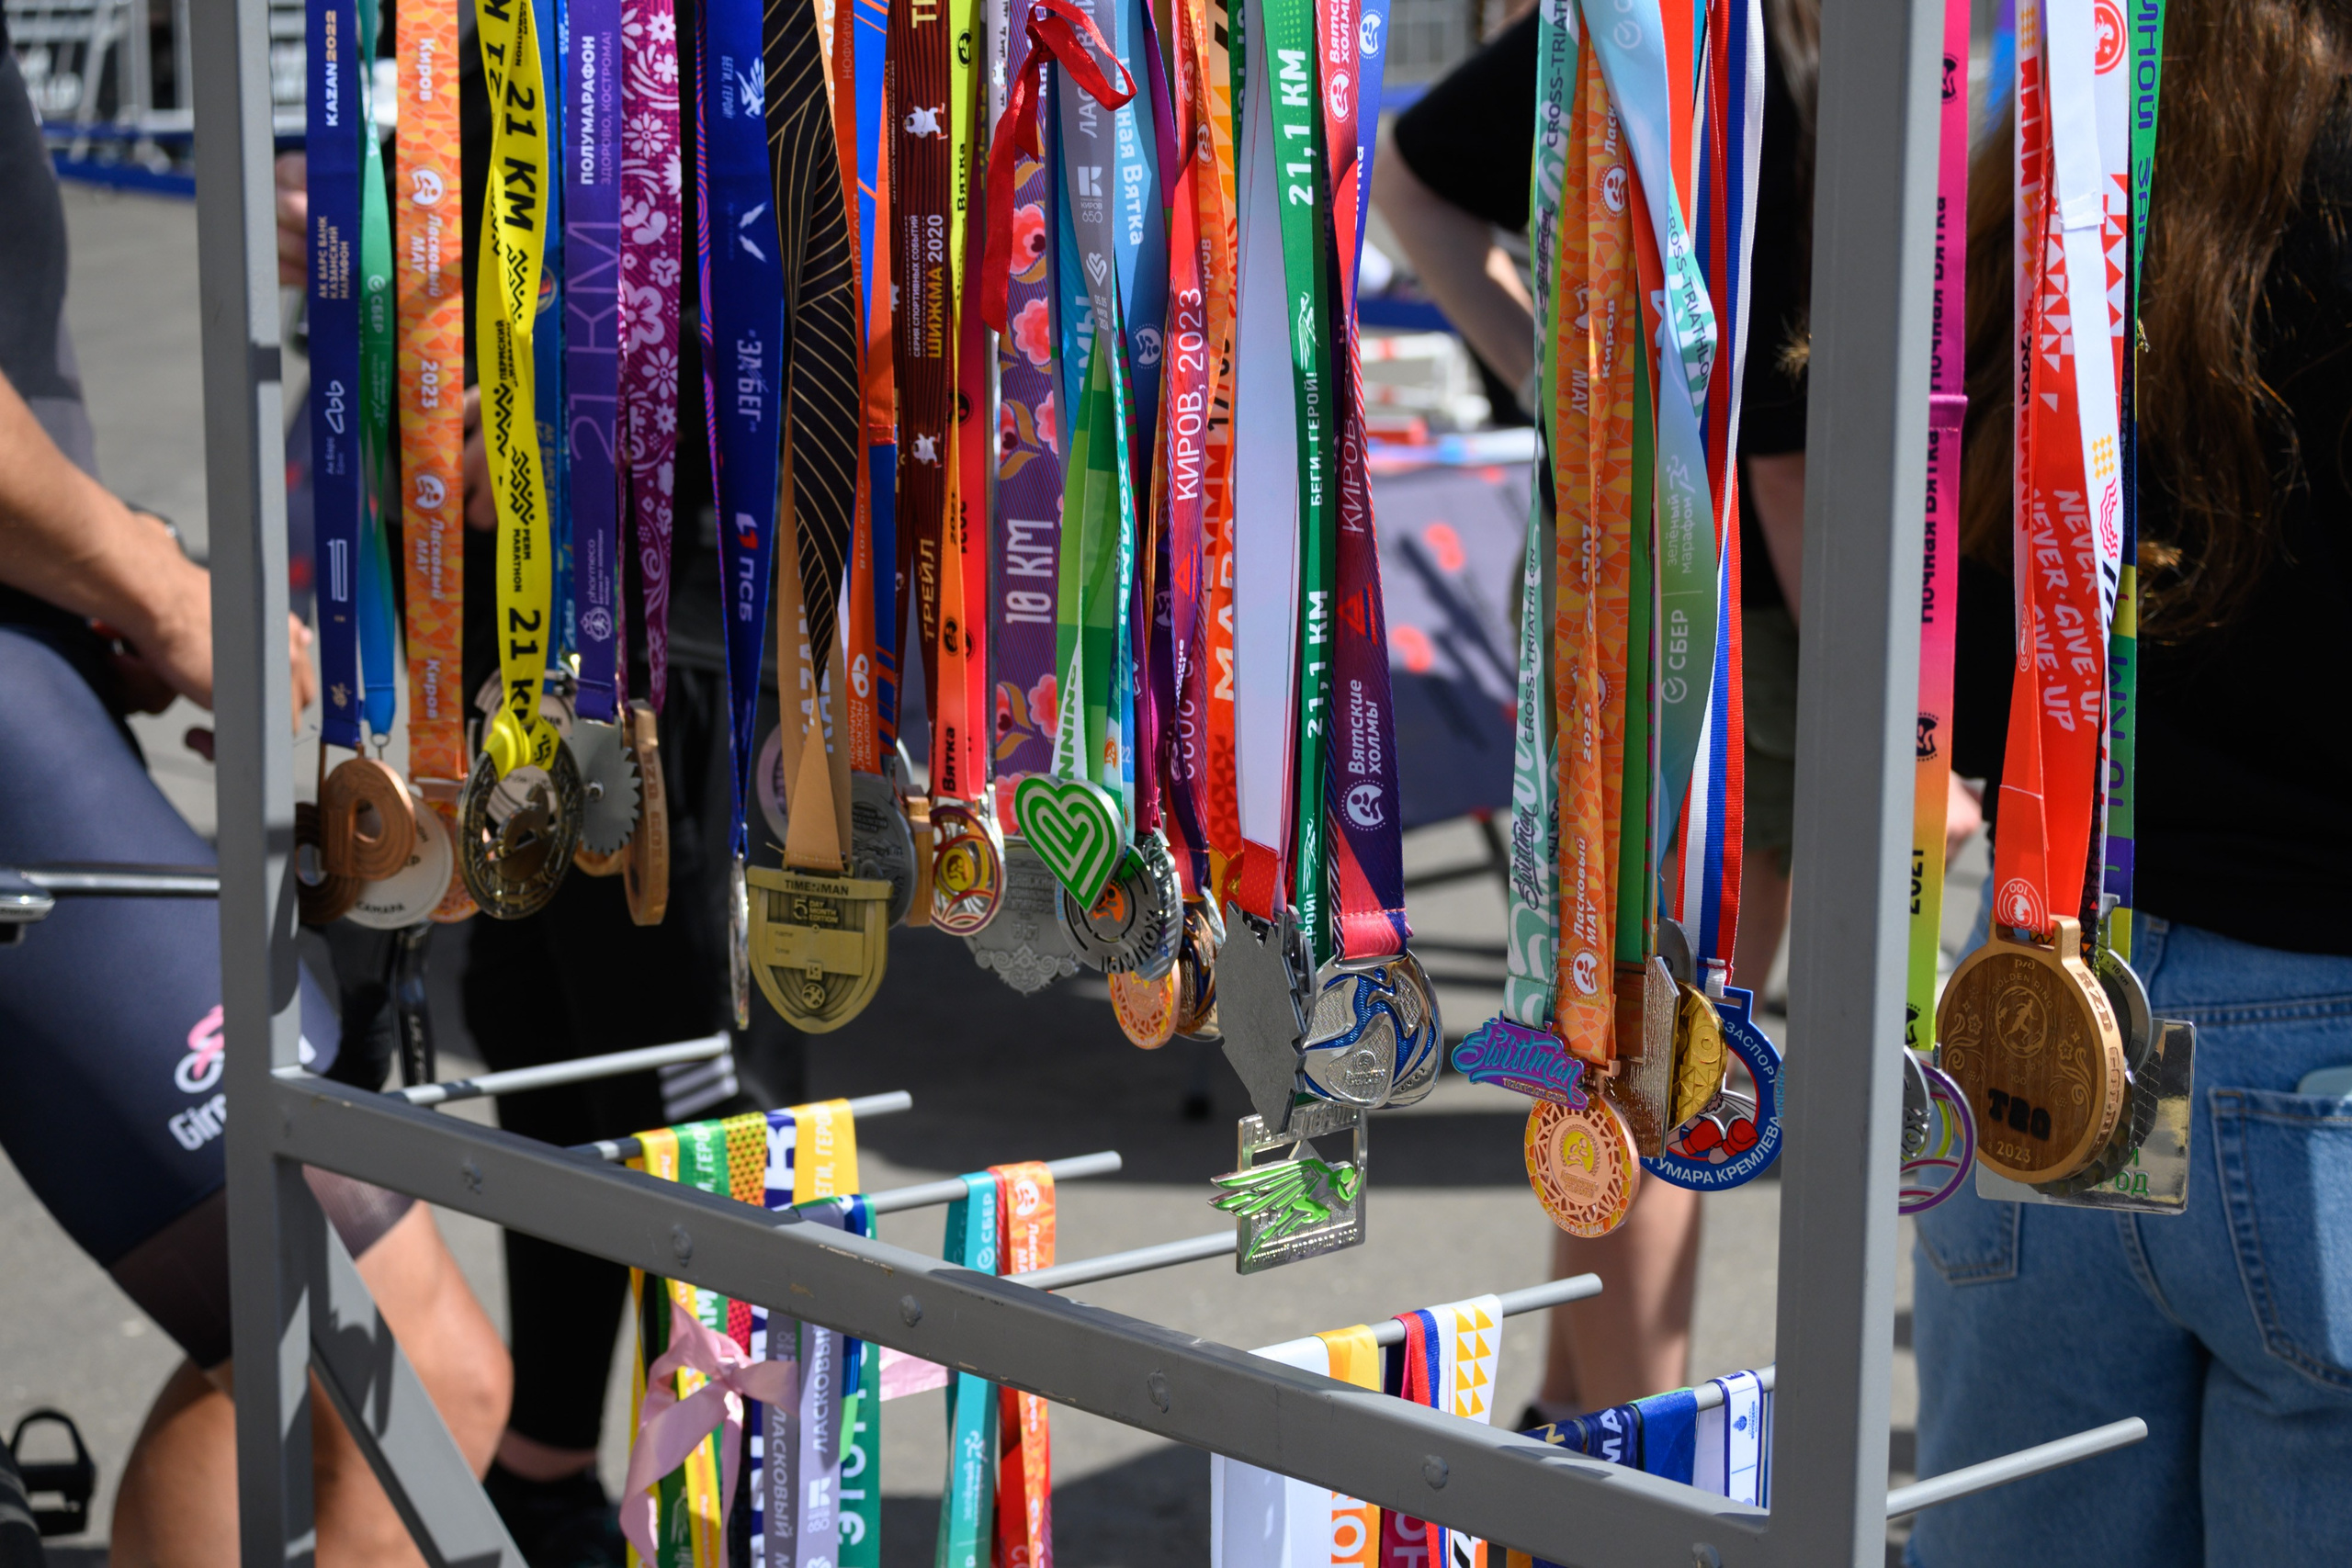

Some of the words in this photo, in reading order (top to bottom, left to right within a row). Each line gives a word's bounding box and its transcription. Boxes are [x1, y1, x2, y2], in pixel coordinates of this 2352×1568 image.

[842, 9, 853, 80] МАРАФОН
[1329, 0, 1340, 64] Вятс
[325, 9, 338, 127] KAZAN2022
[419, 37, 435, 102] Киров
[600, 31, 613, 112] КОСТРОМА!
[721, 55, 733, 84] БЕГИ,
[505, 81, 537, 137] 21
[581, 36, 595, 185] ПОЛУМАРАФОН
[721, 86, 733, 119] ГЕРОЙ!
[600, 116, 613, 186] ЗДОРОВО,
[956, 143, 966, 211] Вятка
[1283, 124, 1317, 207] 21,1
[912, 214, 921, 261] СОБЫТИЙ
[1080, 201, 1102, 210] КИРОВ
[1082, 210, 1102, 223] 650
[1122, 164, 1145, 246] Вятка
[329, 225, 339, 300] КАЗАНСКИЙ
[341, 241, 350, 299] МАРАФОН
[427, 212, 444, 298] Ласковый
[927, 214, 944, 264] 2020
[370, 294, 384, 333] СБЕР
[912, 263, 921, 331] СПОРТИВНЫХ
[927, 266, 944, 359] ШИЖМА
[1094, 295, 1108, 308] 05.05
[1177, 288, 1204, 373] 2023
[1601, 299, 1615, 378] Киров
[420, 360, 438, 410] 2023
[1305, 371, 1320, 442] ГЕРОЙ!
[1176, 384, 1205, 502] КИРОВ,
[1341, 412, 1364, 535] КИРОВ,
[1308, 449, 1324, 507] БЕГИ,
[430, 517, 446, 602] Ласковый
[514, 528, 523, 593] MARATHON
[523, 528, 531, 561] PERM
[1667, 491, 1680, 568] зелёный
[1681, 496, 1696, 575] марафон
[585, 539, 597, 604] pharmeco
[739, 557, 754, 622] ПСБ
[920, 538, 935, 642] ТРЕЙЛ
[509, 607, 541, 660] 21
[1004, 591, 1053, 626] 10
[1669, 609, 1689, 671] СБЕР
[2054, 604, 2098, 676] GIVE
[1524, 547, 1536, 744] CROSS-TRIATHLON
[424, 658, 439, 719] Киров
[1307, 660, 1329, 739] 21,1
[2042, 684, 2075, 732] UP
[849, 698, 857, 765] МАРАФОН
[863, 703, 872, 768] АБСОЛЮТ
[942, 727, 956, 793] Вятка
[1348, 679, 1363, 775] Вятские
[1366, 700, 1382, 775] холмы
[793, 898, 808, 920] 5
[1573, 837, 1587, 939] Ласковый
[1992, 973, 2031, 995] GOLDEN
[2033, 980, 2054, 1010] RING
[1453, 1025, 1587, 1106] Swiftman
[2010, 1074, 2028, 1086] 100
[1657, 1161, 1714, 1185] УМАРА
[1715, 1116, 1781, 1184] КРЕМЛЕВА
[1996, 1140, 2031, 1164] 2023
[980, 1192, 995, 1244] СБЕР
[772, 1404, 793, 1539] ЛАСКОВЫЙ
